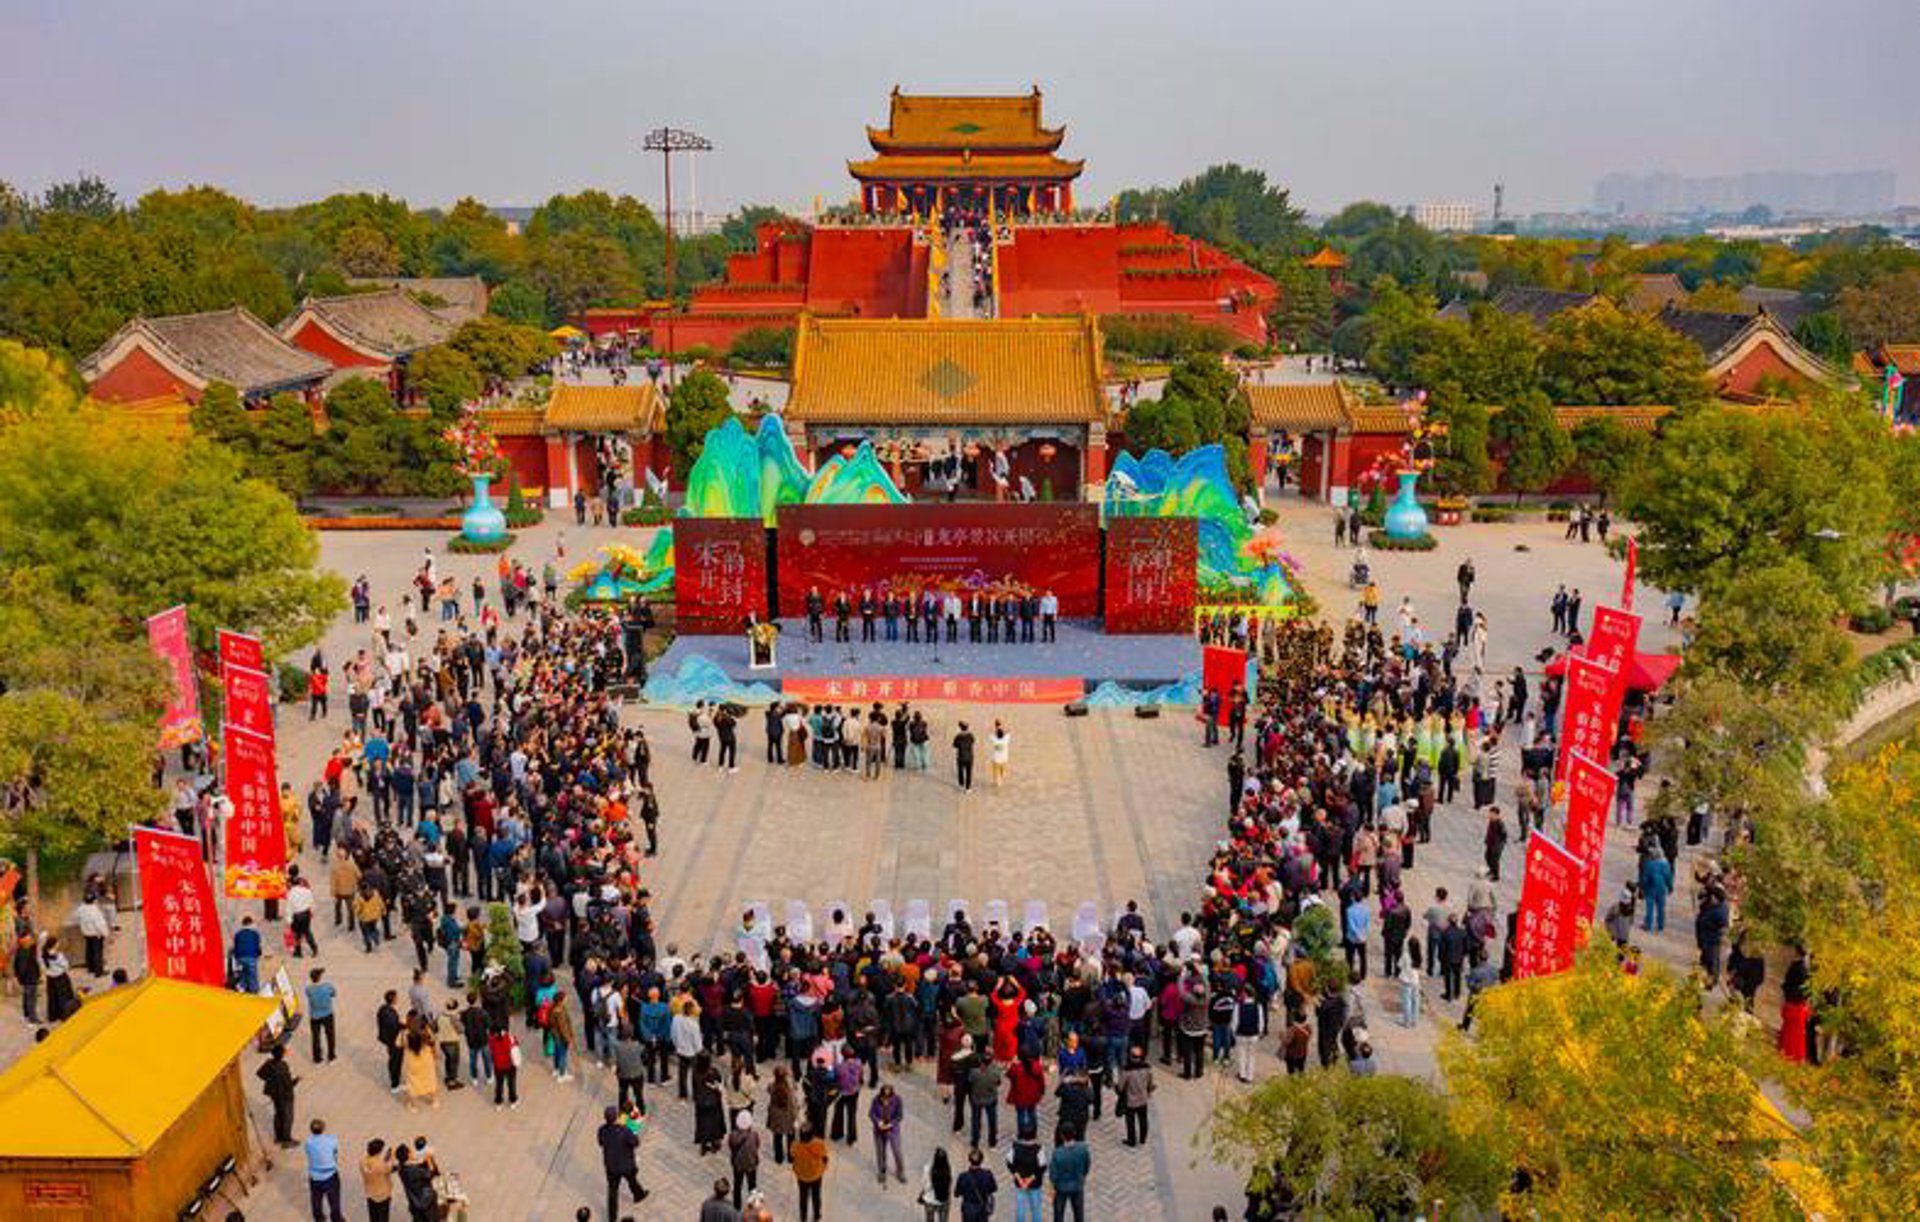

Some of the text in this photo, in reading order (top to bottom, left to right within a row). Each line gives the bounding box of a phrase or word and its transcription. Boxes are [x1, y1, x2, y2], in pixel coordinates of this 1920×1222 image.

[825, 680, 919, 698] 宋韵开封
[163, 894, 187, 976] 菊香中国
[178, 879, 206, 954] 宋韵开封
